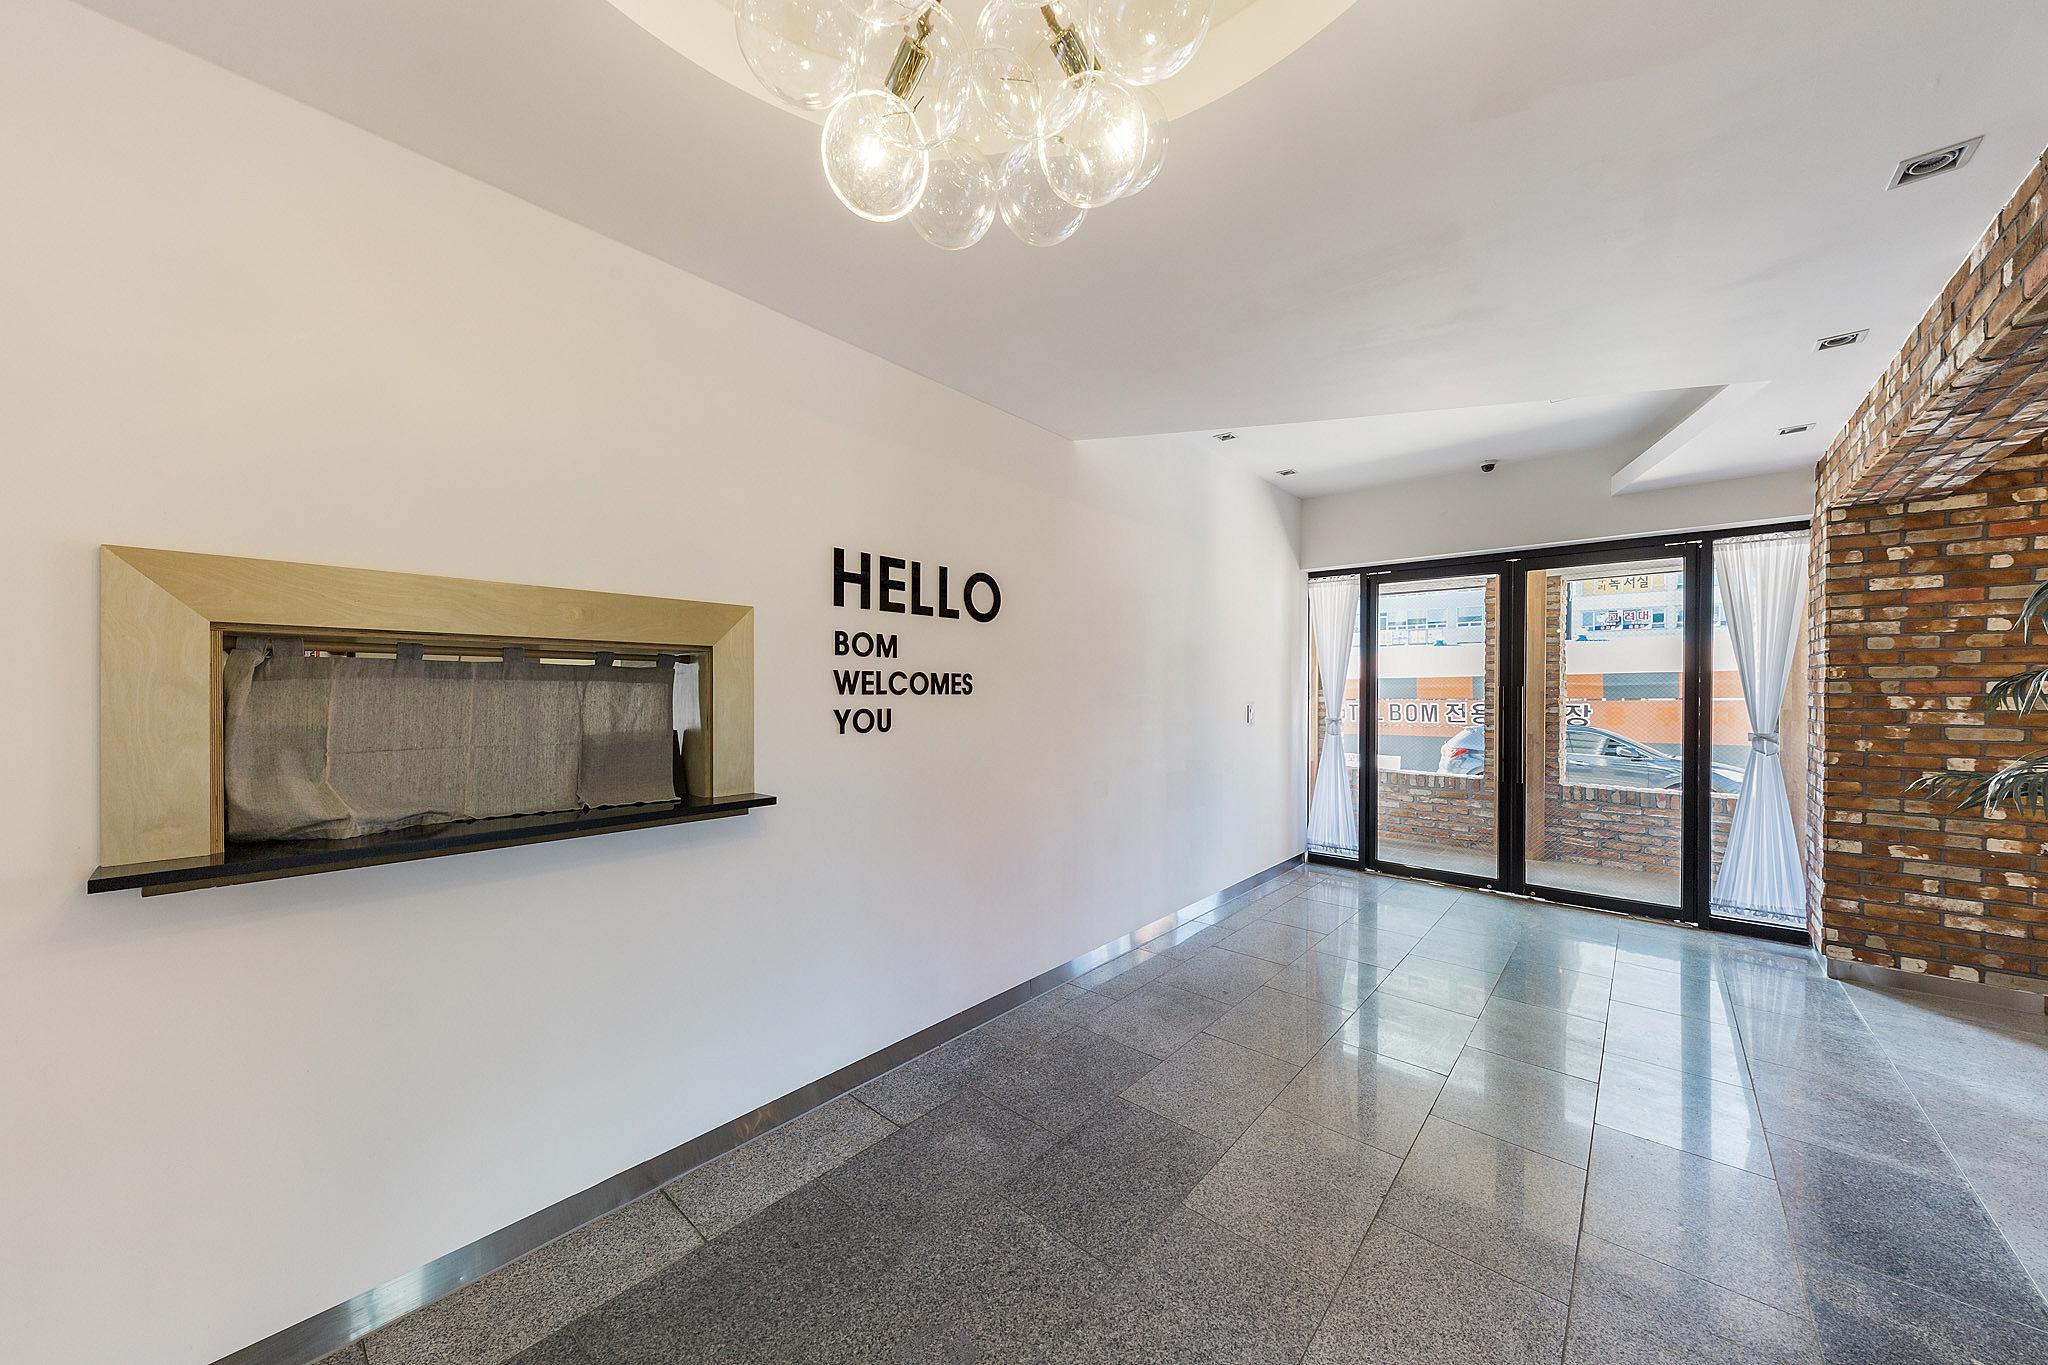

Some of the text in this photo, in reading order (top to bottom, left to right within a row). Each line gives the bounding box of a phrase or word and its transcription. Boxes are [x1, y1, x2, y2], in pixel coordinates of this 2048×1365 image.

[833, 547, 1001, 623] HELLO
[834, 630, 898, 658] BOM
[833, 669, 973, 696] WELCOMES
[833, 708, 892, 734] YOU
[1389, 703, 1438, 723] BOM
